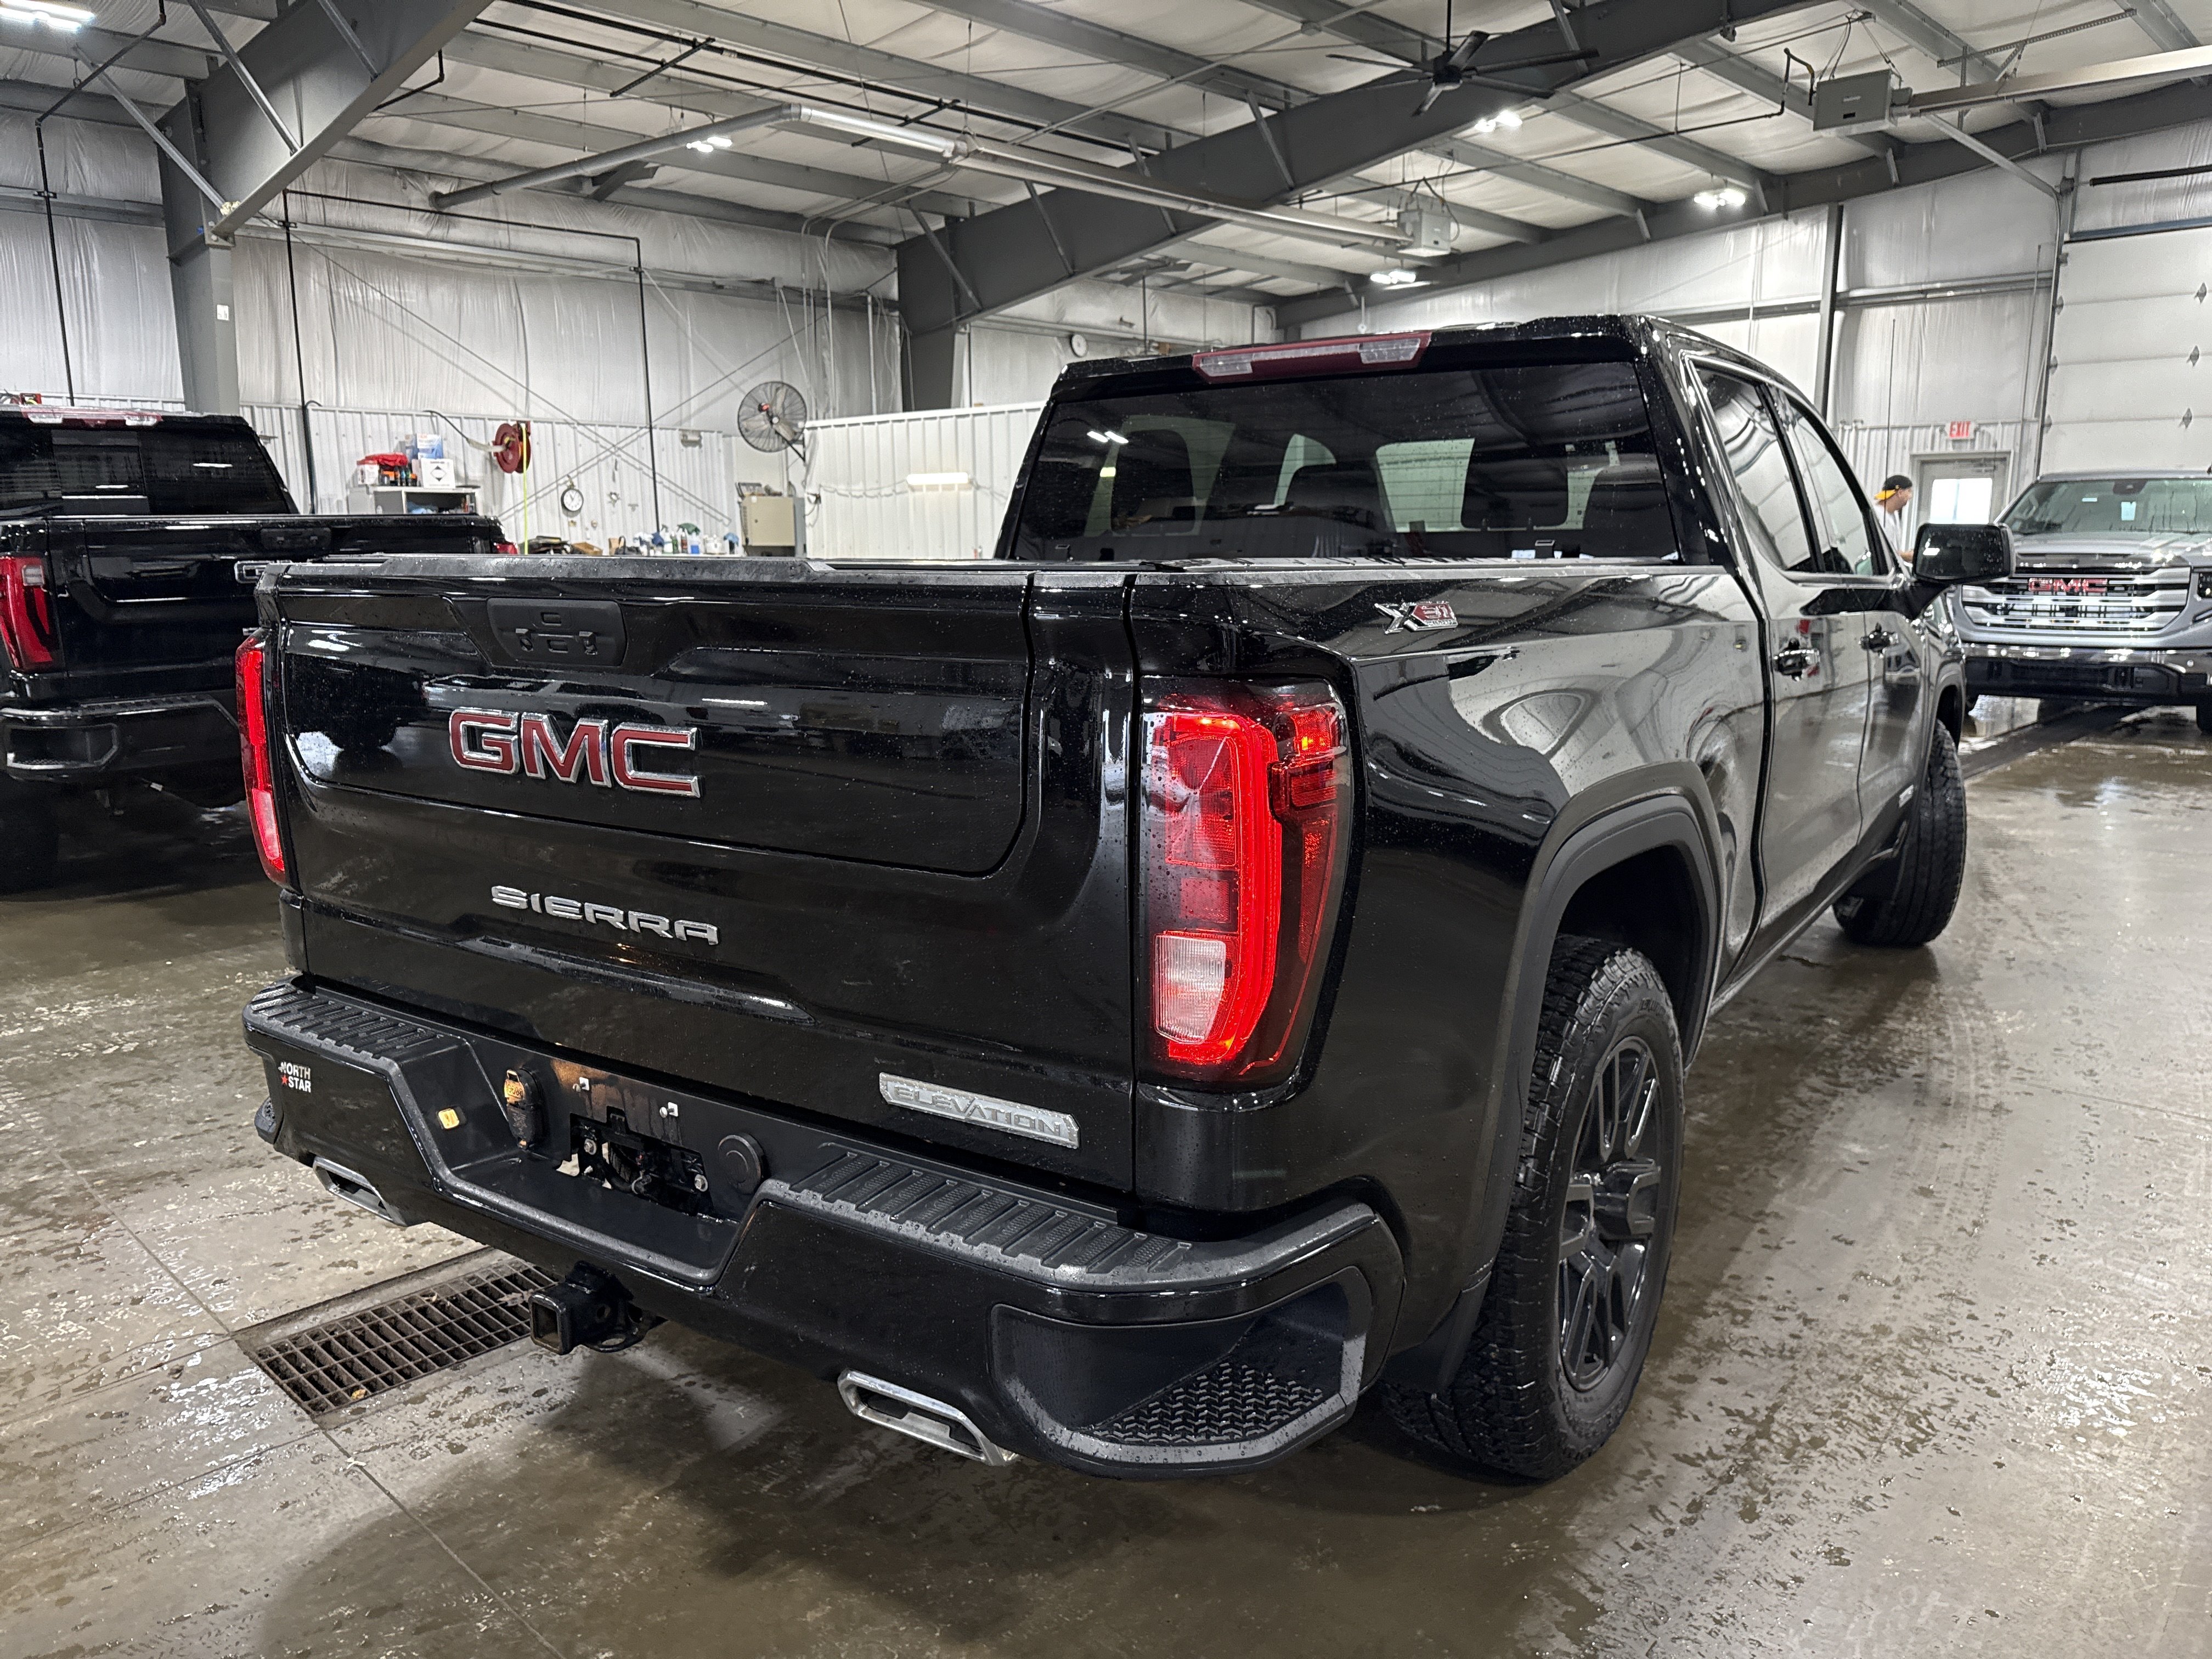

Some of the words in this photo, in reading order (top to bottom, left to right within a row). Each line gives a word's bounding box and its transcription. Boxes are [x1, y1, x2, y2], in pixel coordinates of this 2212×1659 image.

[1949, 421, 1971, 438] EXIT
[2028, 578, 2108, 592] GMC
[449, 707, 702, 798] GMC
[492, 885, 719, 946] SIERRA
[279, 1062, 311, 1080] NORTH
[288, 1076, 312, 1093] STAR
[893, 1084, 1062, 1138] ELEVATION
